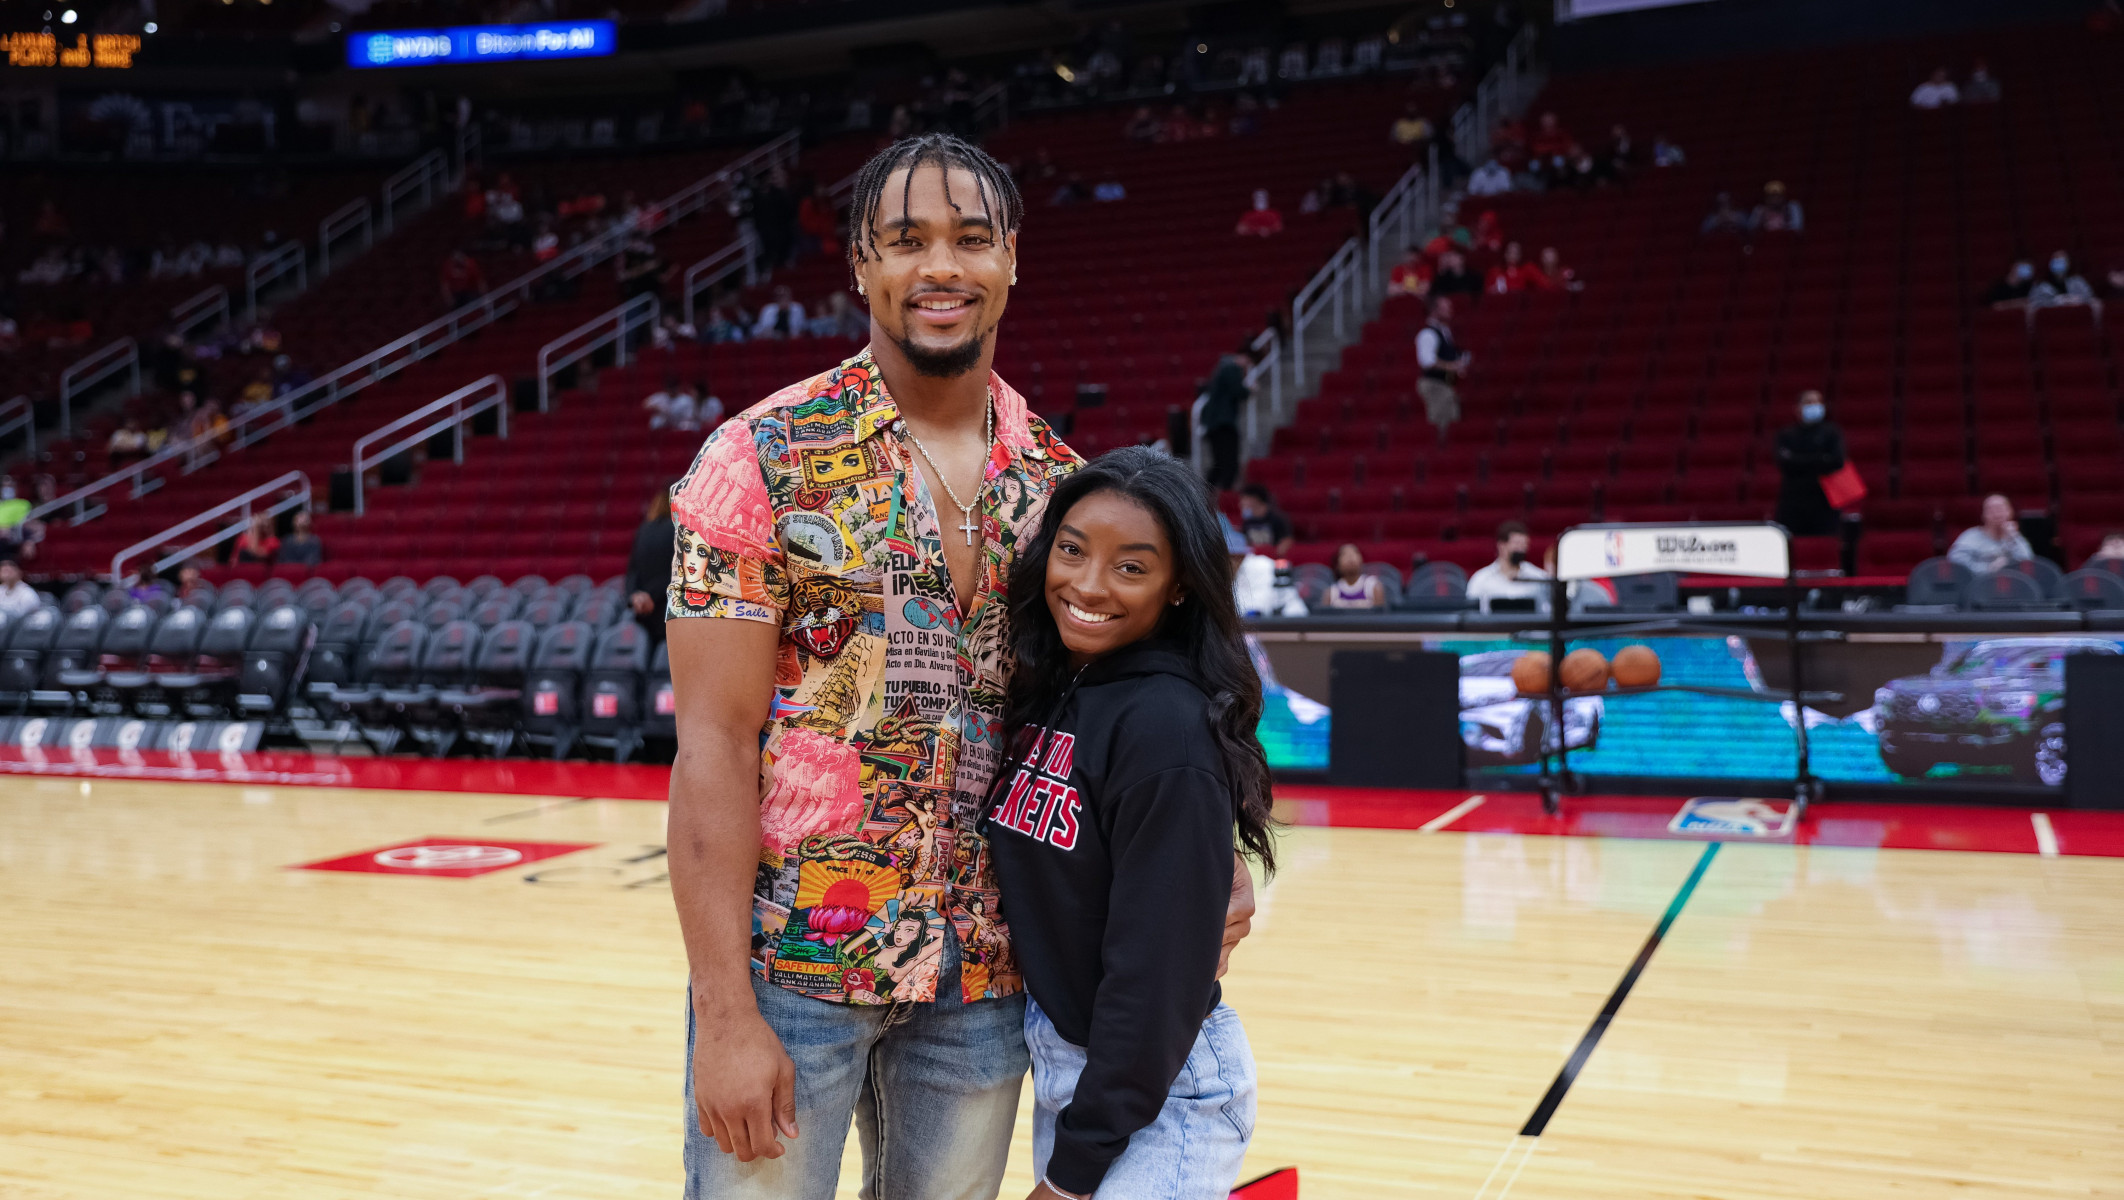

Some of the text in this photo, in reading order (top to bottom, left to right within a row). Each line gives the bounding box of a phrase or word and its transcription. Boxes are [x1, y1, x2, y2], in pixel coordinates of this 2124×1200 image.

[393, 34, 451, 58] NYDIG
[535, 29, 570, 51] For
[568, 27, 594, 49] All
[803, 456, 813, 480] SPECIAL
[1048, 466, 1067, 476] LOVE
[816, 480, 842, 489] SAFETY
[843, 475, 867, 485] MATCH
[792, 509, 836, 534] STEAMSHIP
[830, 534, 844, 561] LINES
[1656, 534, 1737, 554] Wilson
[736, 605, 769, 618] Sails
[887, 631, 914, 645] ACTO
[918, 631, 930, 646] EN
[932, 633, 944, 647] SU
[885, 647, 902, 657] Misa
[941, 651, 946, 661] y
[885, 659, 902, 669] Acto
[904, 660, 913, 669] en
[929, 660, 953, 672] Alvarez
[885, 681, 958, 698] TU PUEBLO TU
[969, 744, 977, 759] EN
[976, 747, 985, 760] SU
[988, 768, 1082, 851] KETS
[827, 865, 848, 874] PRICE
[775, 959, 821, 974] SAFETY
[774, 971, 795, 979] VALLI
[795, 973, 822, 983] MATCH
